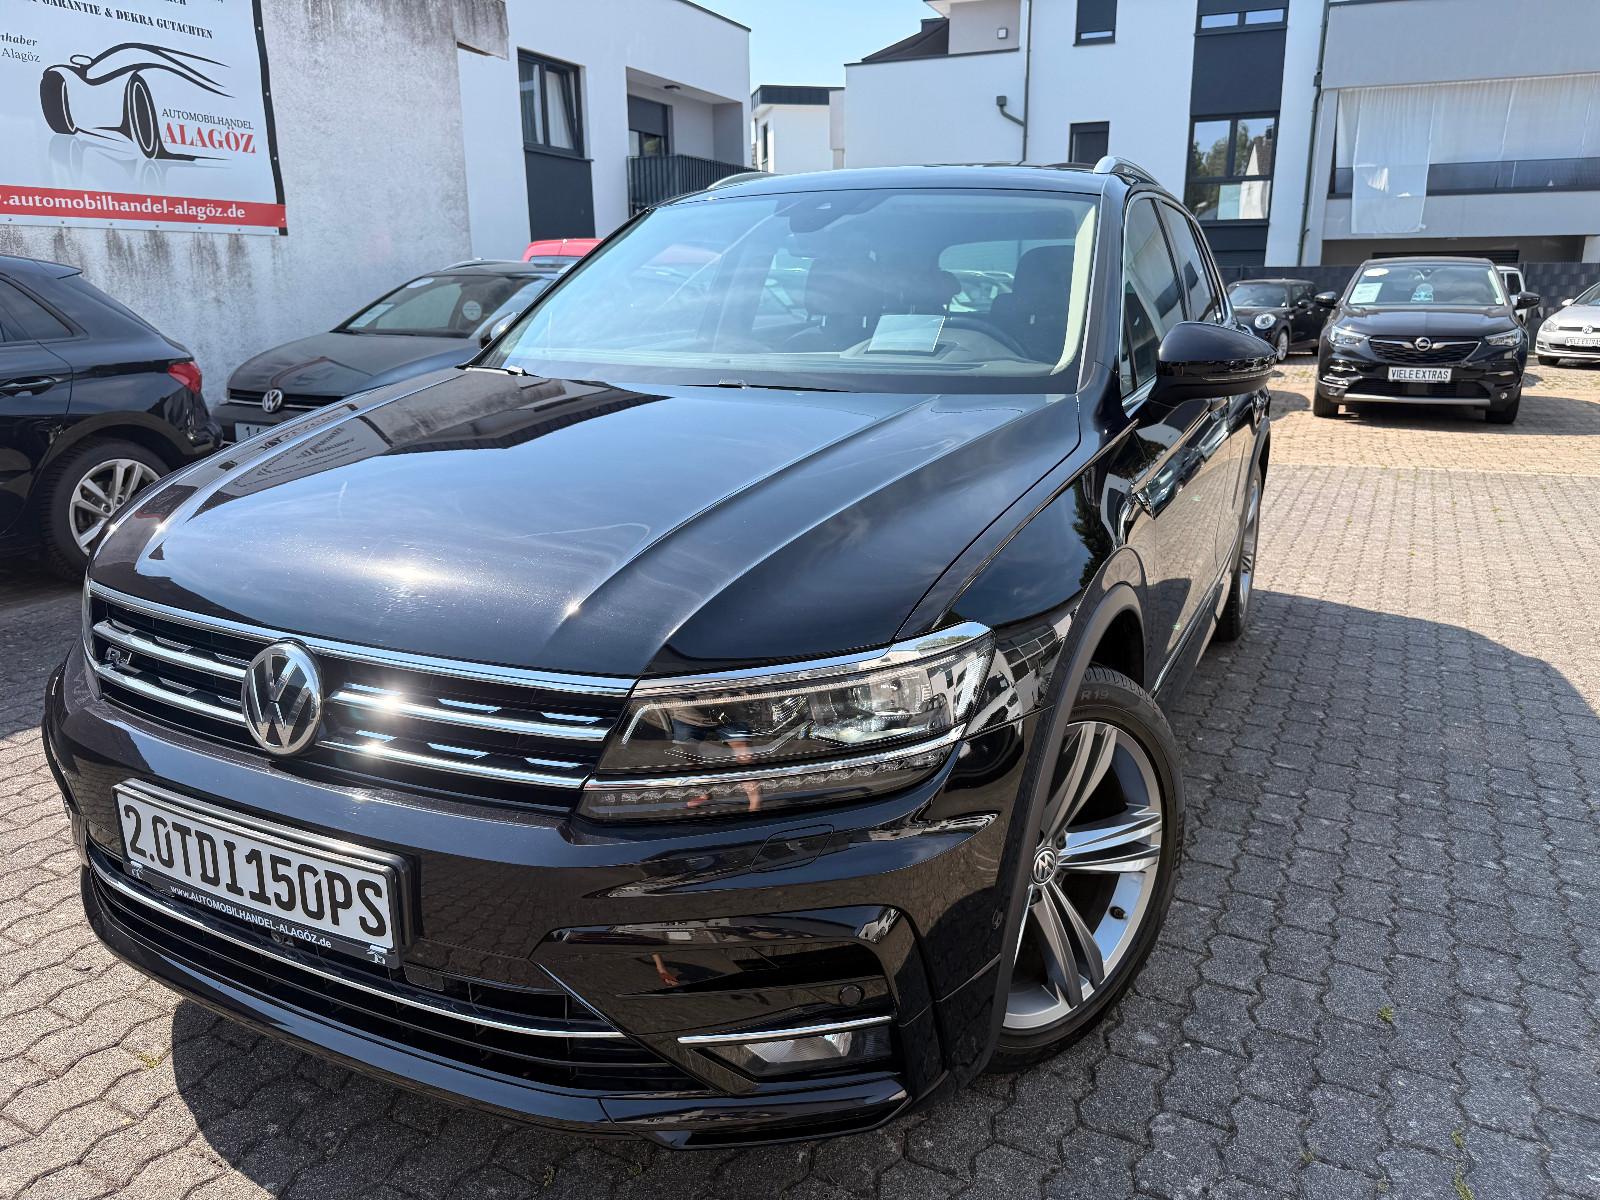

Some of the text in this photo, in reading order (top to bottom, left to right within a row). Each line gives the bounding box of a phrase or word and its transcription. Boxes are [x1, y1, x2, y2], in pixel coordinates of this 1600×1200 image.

[104, 8, 113, 18] &
[116, 9, 154, 27] DEKRA
[157, 18, 213, 39] GUTACHTEN
[1, 47, 41, 63] Alagöz
[162, 108, 254, 130] AUTOMOBILHANDEL
[164, 122, 256, 154] ALAGÖZ
[0, 193, 246, 220] .automobilhandel-alagöz.de
[170, 886, 332, 949] www.AUTOMOBILHANDEL-ALAGÖZ.de
